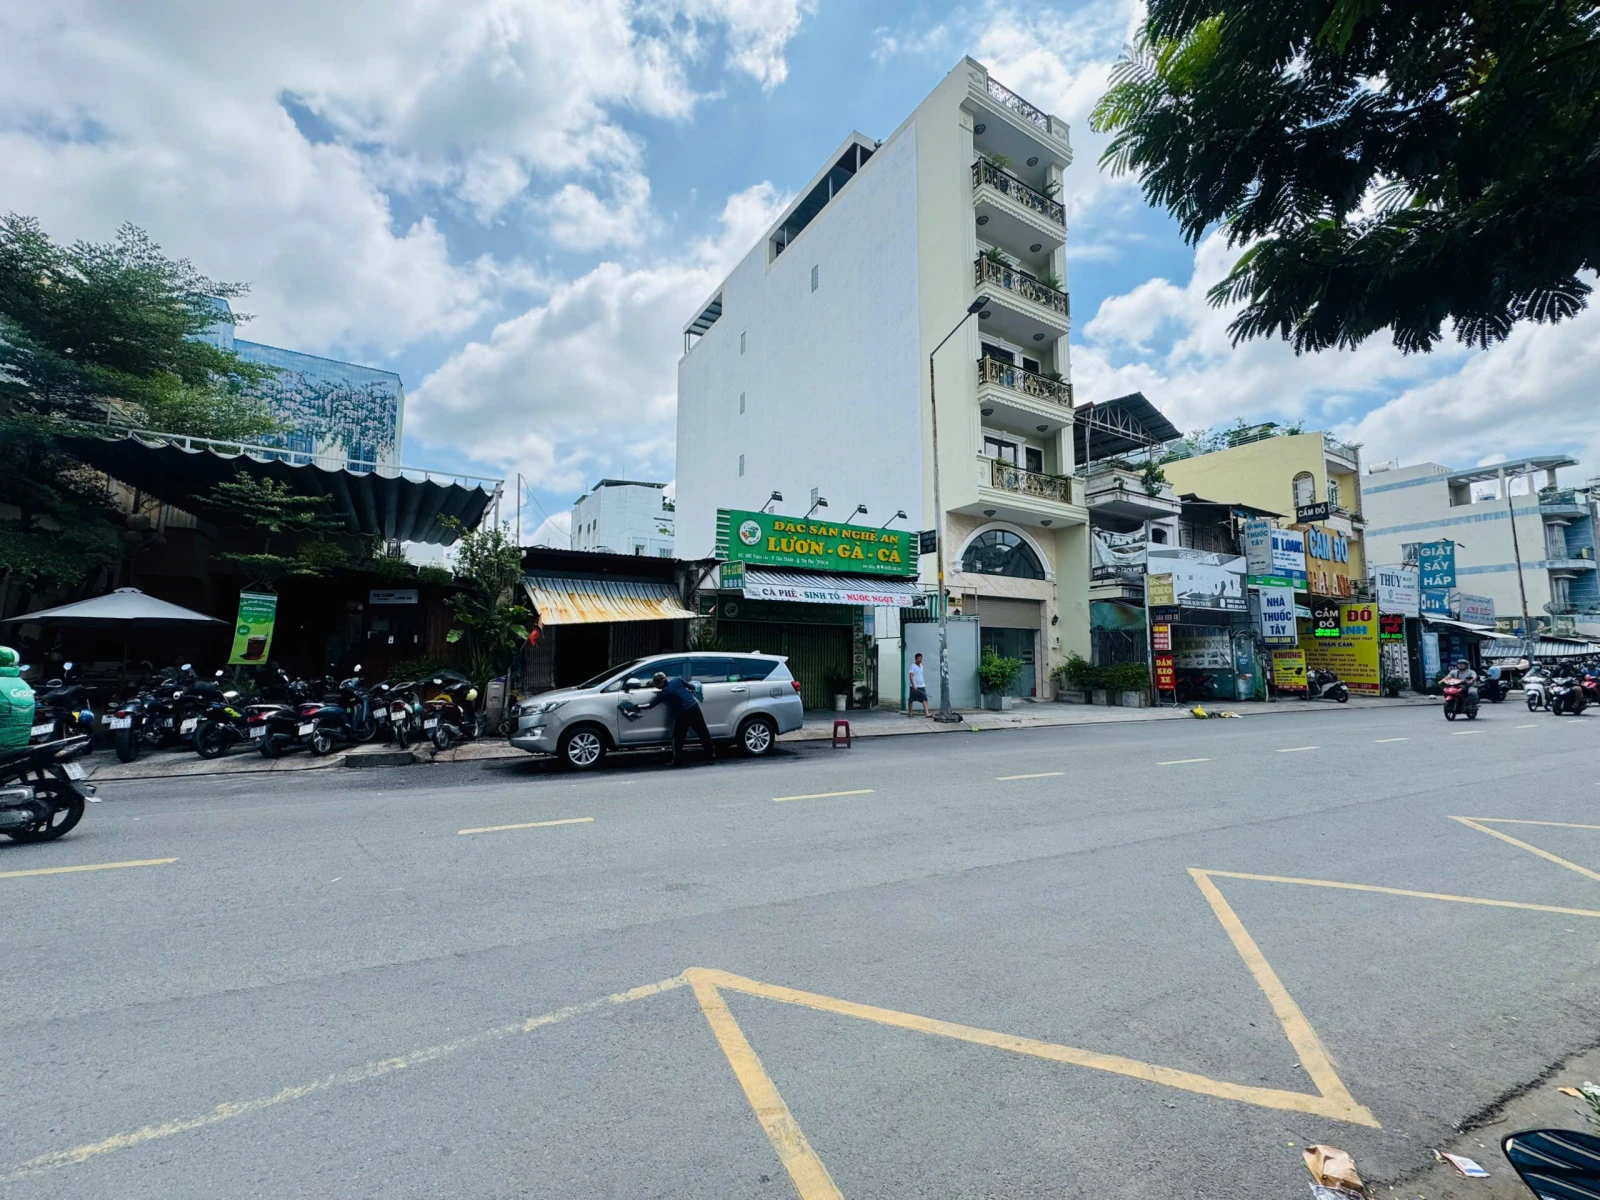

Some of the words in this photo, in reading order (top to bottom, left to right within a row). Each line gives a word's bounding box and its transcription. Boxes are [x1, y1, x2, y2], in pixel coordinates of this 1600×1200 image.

[774, 519, 806, 534] ĐẶC
[809, 521, 839, 537] SẢN
[841, 529, 878, 544] NGHỆ
[880, 535, 899, 543] AN
[1247, 529, 1268, 538] THUỐC
[768, 536, 824, 555] LƯƠN
[837, 542, 865, 559] GÀ
[877, 545, 901, 563] CÁ
[1308, 524, 1331, 561] CẦM
[1332, 531, 1348, 563] ĐỒ
[1420, 545, 1452, 558] GIẶT
[1424, 558, 1450, 571] SẤY
[1379, 571, 1401, 588] THỦY
[1424, 573, 1452, 586] HẤP
[762, 586, 776, 597] CÀ
[779, 588, 798, 598] PHÊ
[804, 591, 826, 599] SINH
[828, 591, 840, 600] TỐ
[847, 593, 871, 602] NƯỚC
[872, 595, 894, 604] NGỌT
[1267, 595, 1285, 607] NHÀ
[1263, 609, 1292, 621] THUỐC
[1347, 605, 1372, 621] ĐỒ
[1270, 624, 1286, 635] TÂY
[1156, 658, 1172, 667] DÁN
